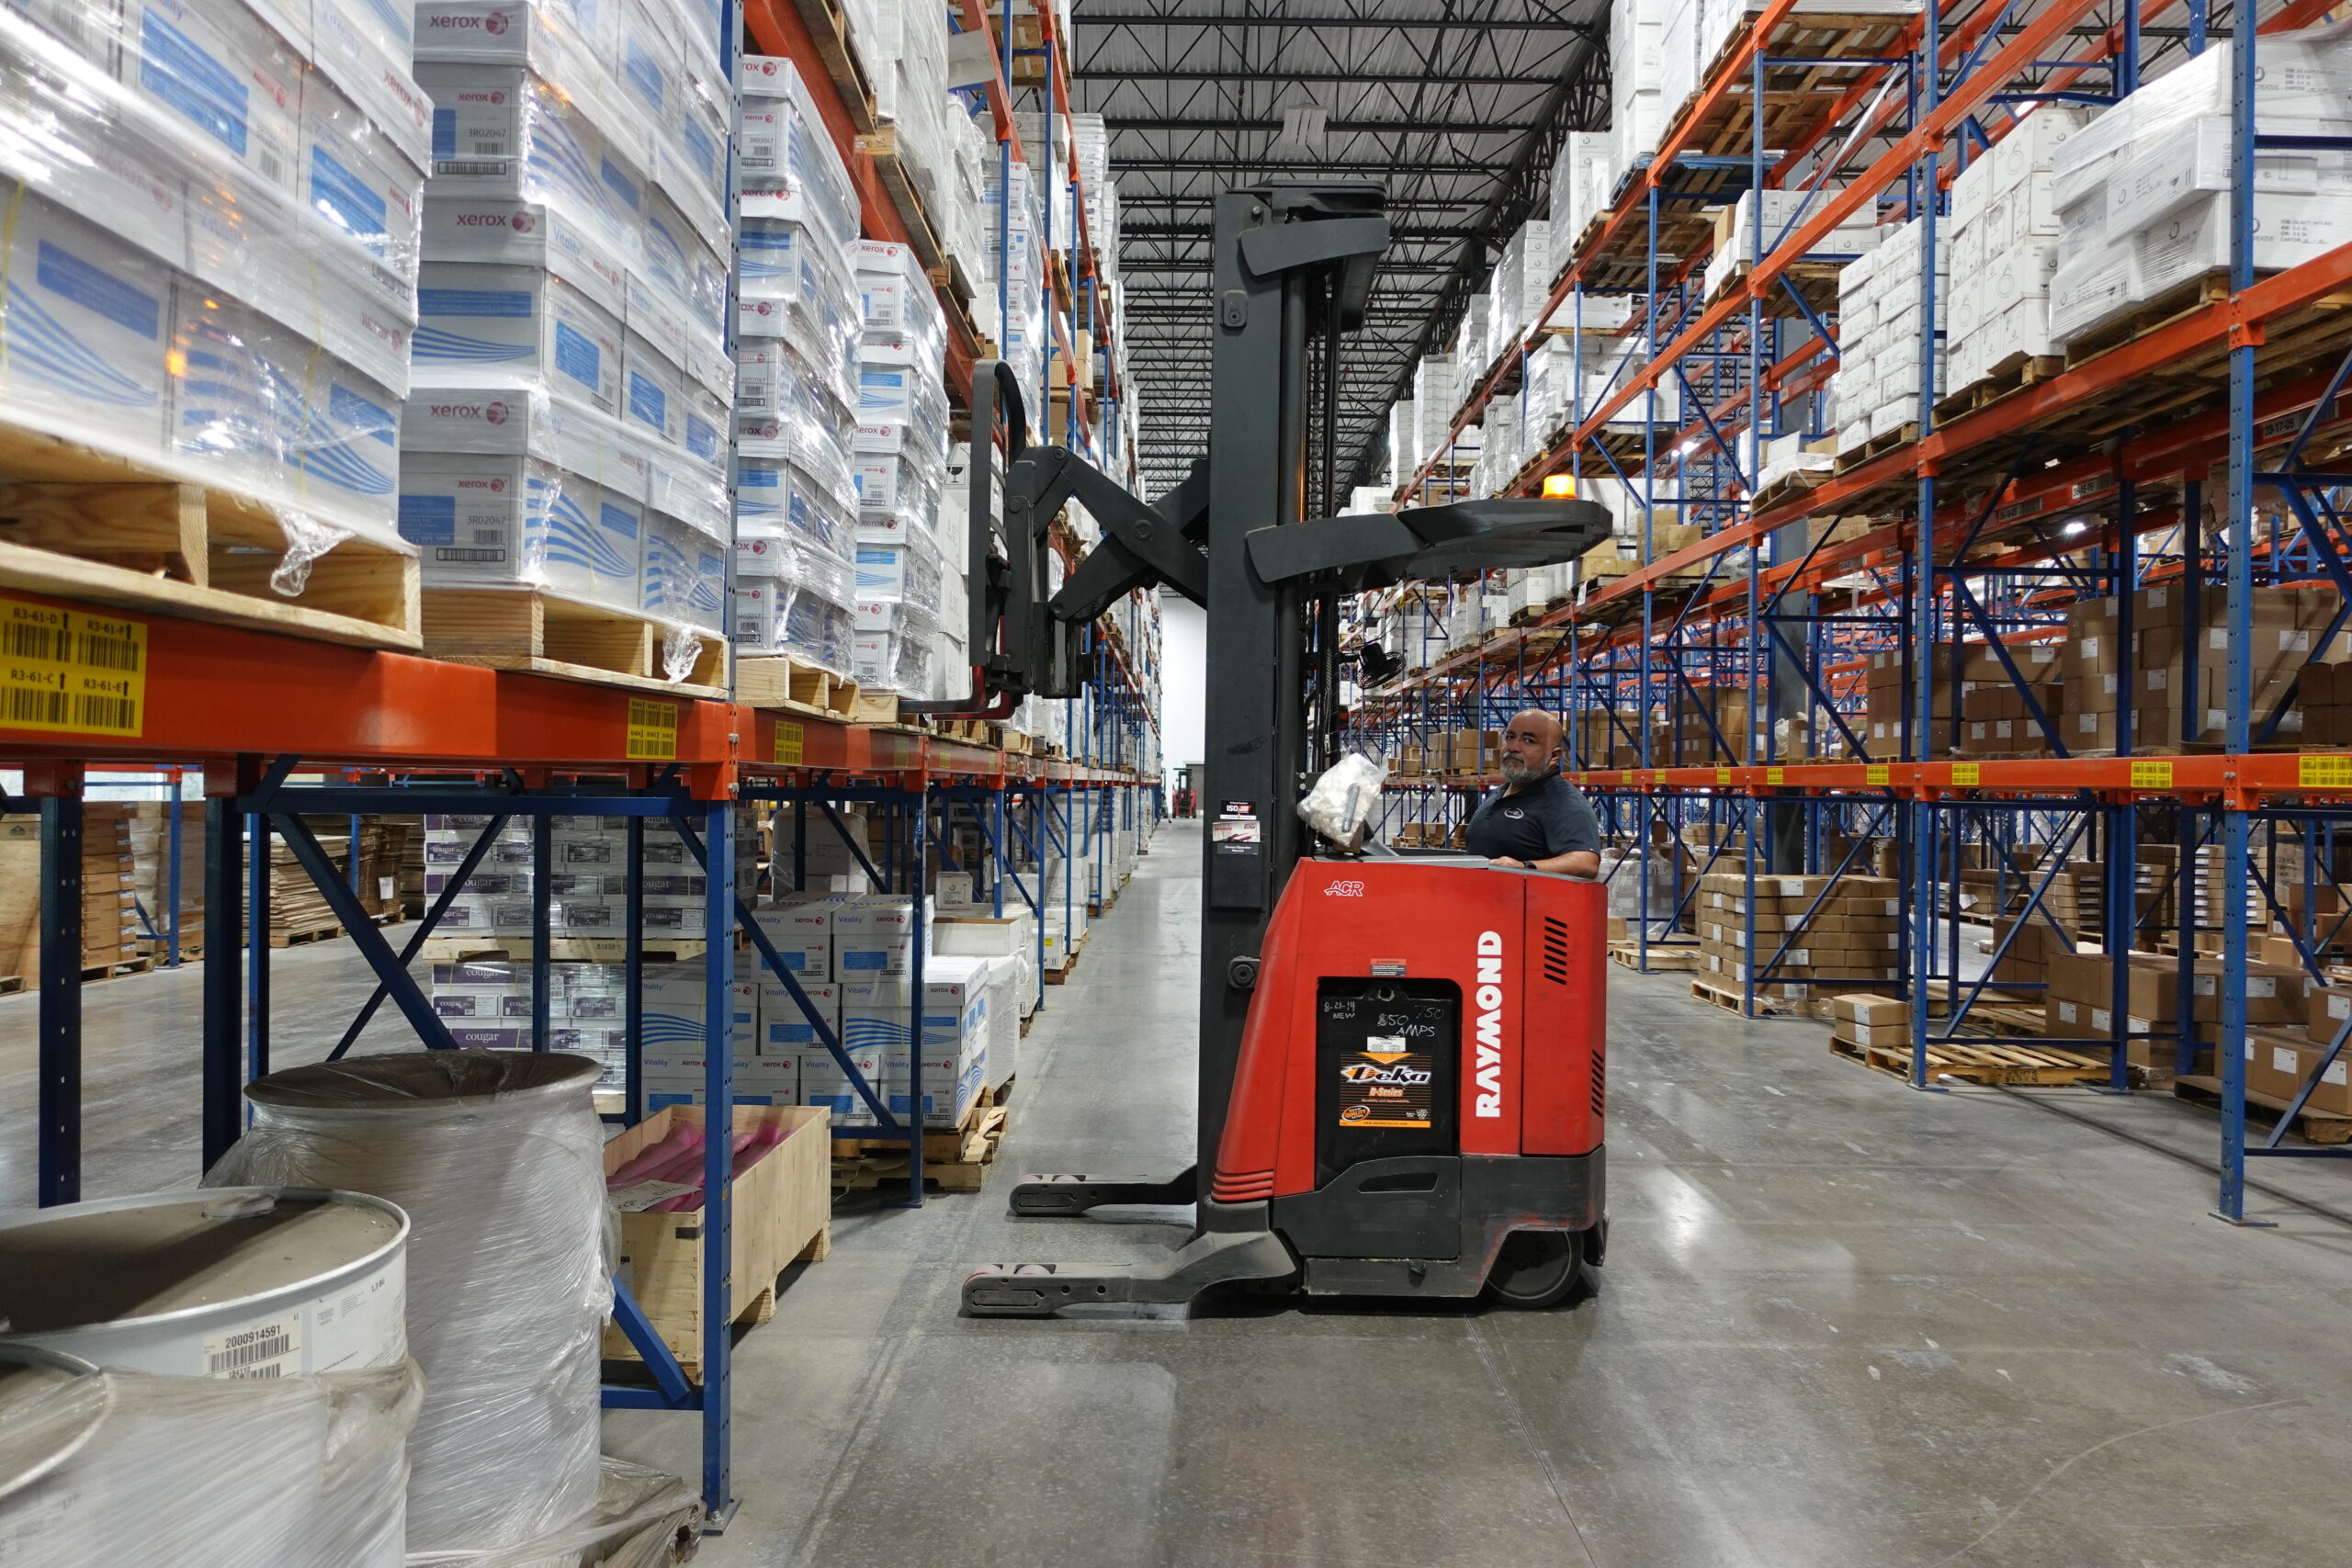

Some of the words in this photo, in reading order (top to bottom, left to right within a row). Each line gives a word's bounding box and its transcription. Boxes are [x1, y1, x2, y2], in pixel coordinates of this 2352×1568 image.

[429, 15, 480, 28] xerox
[458, 93, 489, 102] xerox
[469, 129, 506, 138] 3R02047
[741, 188, 773, 197] xerox
[457, 214, 507, 227] xerox
[554, 227, 582, 259] Vitality
[861, 243, 885, 254] xerox
[430, 405, 481, 418] xerox
[738, 426, 761, 435] erox
[458, 479, 488, 489] xerox
[467, 516, 506, 525] 3R02047
[861, 519, 885, 528] xerox
[14, 608, 57, 625] R3-61-D
[87, 620, 125, 636] R3-61-F
[11, 669, 54, 684] R3-61-C
[84, 678, 121, 693] R3-61-E
[643, 815, 669, 825] ougar
[433, 846, 454, 854] cougar
[1324, 880, 1364, 897] ACR
[756, 916, 780, 924] Vitality
[838, 916, 863, 924] Vitality
[466, 968, 499, 979] cougar
[642, 983, 663, 992] itality
[765, 988, 789, 997] Vitality
[1476, 931, 1503, 1118] RAYMOND
[1396, 1024, 1435, 1037] AMPS
[466, 1032, 500, 1043] cougar
[644, 1059, 669, 1067] Vitality
[1341, 1064, 1430, 1085] Deka
[1369, 1087, 1404, 1097] D-Series
[1345, 1109, 1367, 1119] QUALITY
[225, 1324, 281, 1349] 2000914591
